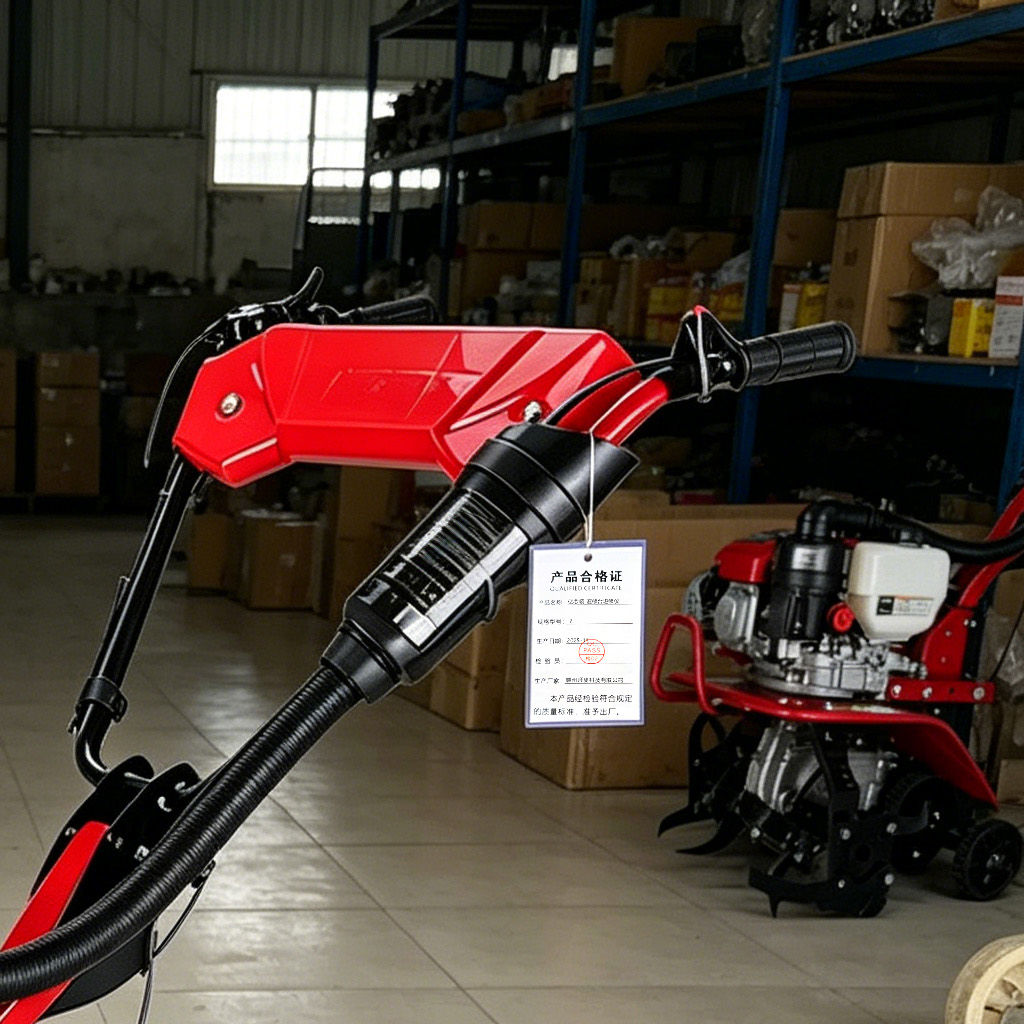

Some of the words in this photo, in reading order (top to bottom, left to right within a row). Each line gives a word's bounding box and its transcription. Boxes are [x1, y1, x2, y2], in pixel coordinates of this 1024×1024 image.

[550, 570, 623, 584] 产品合格证
[549, 694, 633, 703] 本产品经检验符合规定
